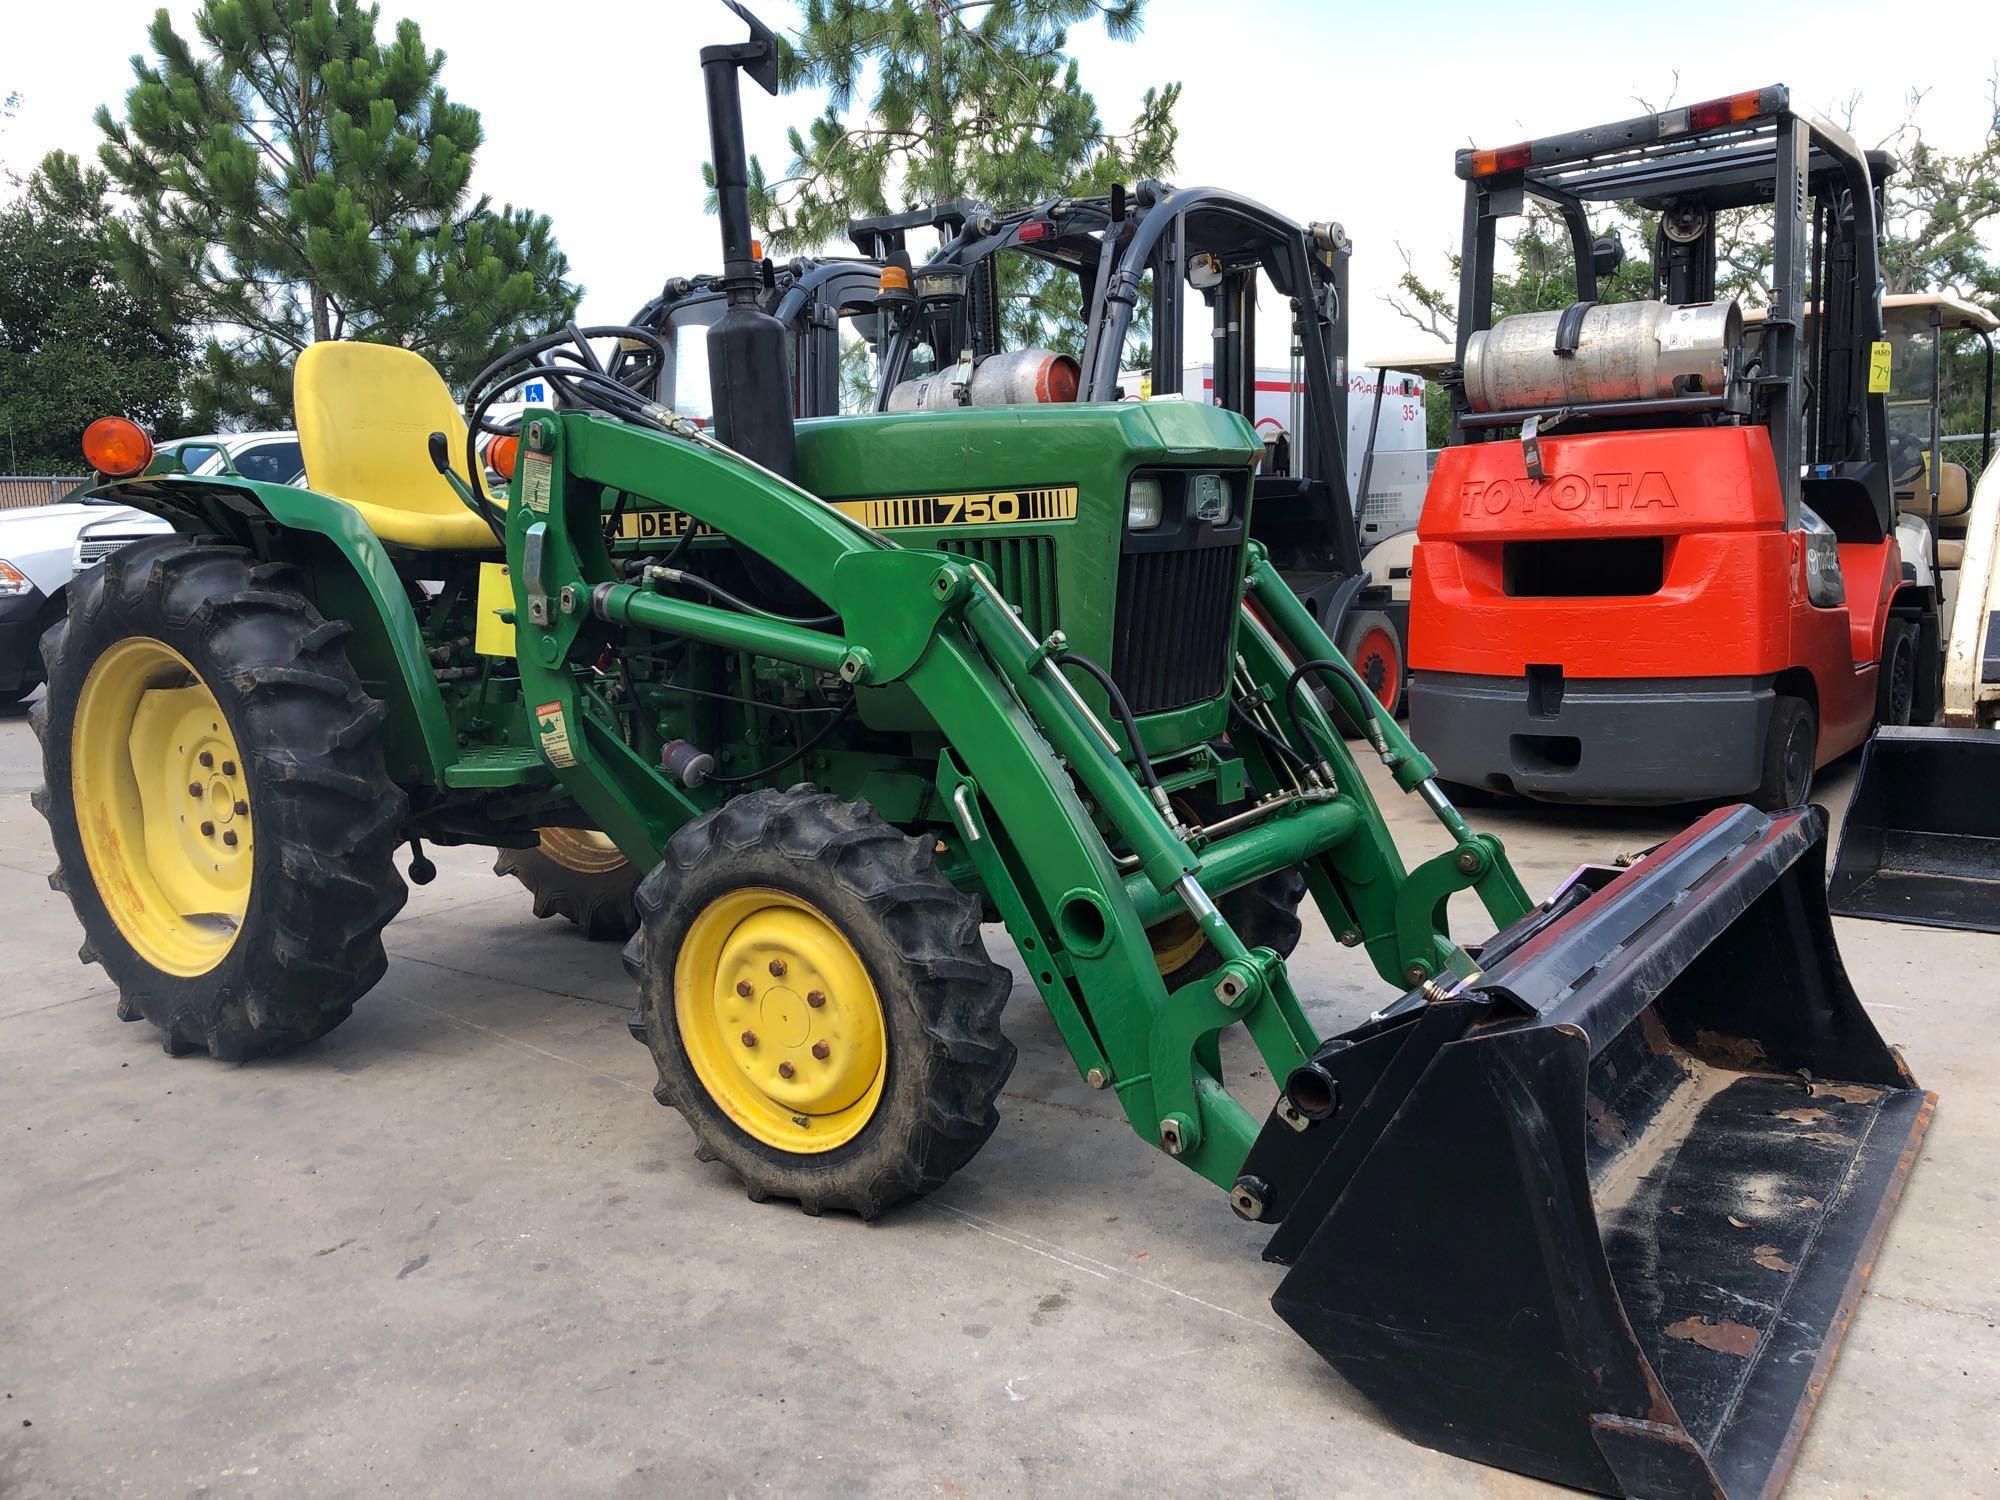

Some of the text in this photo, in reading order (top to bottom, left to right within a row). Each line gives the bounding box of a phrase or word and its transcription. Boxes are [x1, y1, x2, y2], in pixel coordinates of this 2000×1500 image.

[1873, 364, 1890, 381] 74
[1402, 404, 1415, 421] 35
[1460, 470, 1681, 517] TOYOTA
[938, 493, 1020, 525] 750
[640, 511, 718, 537] DEE
